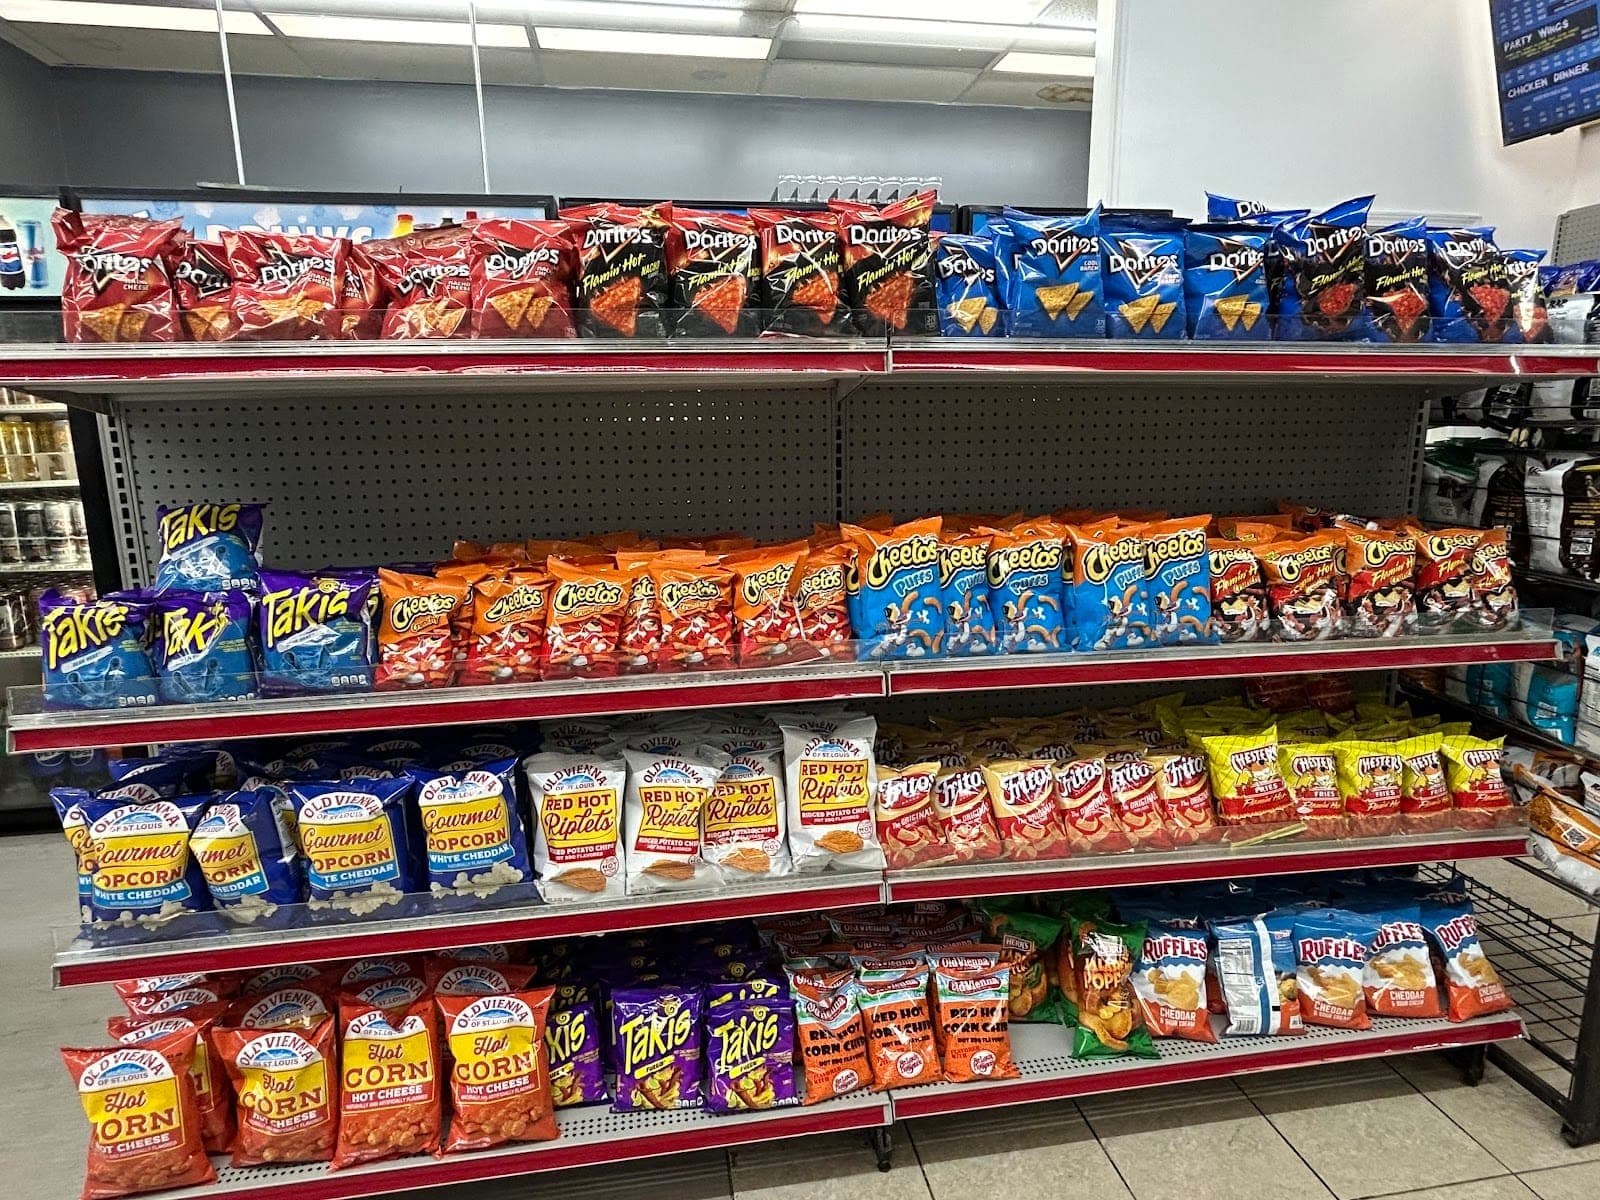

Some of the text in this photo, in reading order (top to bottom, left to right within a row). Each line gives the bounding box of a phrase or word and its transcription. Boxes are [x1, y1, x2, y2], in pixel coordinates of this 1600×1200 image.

[1504, 34, 1532, 52] PARTY
[1538, 19, 1569, 37] WINGS
[1508, 78, 1548, 98] CHICKEN
[1553, 62, 1589, 82] DINNER
[583, 227, 653, 249] Doritos
[684, 228, 757, 250] Doritos
[850, 225, 922, 245] Doritos
[1032, 236, 1099, 256] Doritos
[1369, 238, 1426, 257] Doritos
[622, 252, 647, 276] Hot
[856, 261, 896, 293] Flamin'
[897, 248, 917, 266] Hot
[1110, 254, 1178, 273] Doritos
[868, 536, 940, 589] Cheetos
[989, 540, 1060, 589] Cheetos
[1279, 544, 1333, 583] Cheetos
[484, 586, 544, 622] Cheetos
[553, 583, 623, 613] Cheetos
[661, 579, 720, 611] Cheetos
[390, 595, 457, 632] Cheetos
[805, 737, 820, 756] OLD
[543, 764, 608, 792] OLD VIENNA
[643, 759, 703, 784] OLD VIENNA
[802, 764, 864, 776] RED HOT
[1055, 759, 1101, 797] Fritos
[424, 779, 449, 800] OLD
[644, 790, 704, 803] RED HOT
[740, 783, 770, 795] HOT
[878, 773, 935, 809] Fritos
[304, 795, 379, 818] OLD VIENNA
[546, 794, 611, 811] RED HOT
[707, 795, 772, 823] Riplets
[802, 810, 825, 818] RIDGED
[827, 808, 850, 817] POTATO
[95, 801, 179, 834] OLD VIENNA
[135, 822, 162, 831] LOUIS
[424, 803, 501, 836] Gourmet
[545, 808, 613, 841] Riplets
[901, 807, 934, 827] ORIGINAL
[303, 823, 385, 853] Gourmet
[429, 827, 507, 850] POPCORN
[98, 840, 183, 868] Gourmet
[429, 853, 460, 863] WHITE
[463, 843, 511, 860] CHEDDAR
[341, 863, 395, 881] CHEDDAR
[128, 882, 185, 900] CHEDDAR
[1143, 936, 1206, 962] RUFFLES
[941, 958, 990, 971] Old Vienna
[442, 970, 464, 991] OLD
[968, 978, 1000, 992] Vienna
[245, 991, 317, 1028] OLD VIENNA
[458, 999, 529, 1028] OLD VIENNA
[871, 1011, 897, 1023] RED
[950, 1008, 977, 1019] RED
[1160, 1008, 1196, 1021] CHEDDAR
[1314, 1001, 1353, 1016] CHEDDAR
[351, 1013, 377, 1034] OLD
[838, 1022, 861, 1040] HOT
[943, 1023, 980, 1034] CORN
[240, 1036, 313, 1066] OLD VIENNA
[368, 1043, 403, 1062] Hot
[474, 1035, 508, 1057] Hot
[805, 1043, 841, 1057] CORN
[83, 1050, 164, 1088] OLD VIENNA
[346, 1061, 428, 1089] CORN
[456, 1051, 532, 1081] CORN
[98, 1072, 149, 1086] OF ST. LOUIS
[263, 1073, 296, 1094] Hot
[466, 1085, 483, 1094] HOT
[486, 1075, 530, 1093] CHEESE
[105, 1090, 146, 1113] Hot
[242, 1087, 321, 1116] CORN
[352, 1091, 375, 1102] HOT
[378, 1085, 422, 1099] CHEESE
[271, 1111, 317, 1128] CHEESE
[117, 1132, 170, 1153] CHEESE
